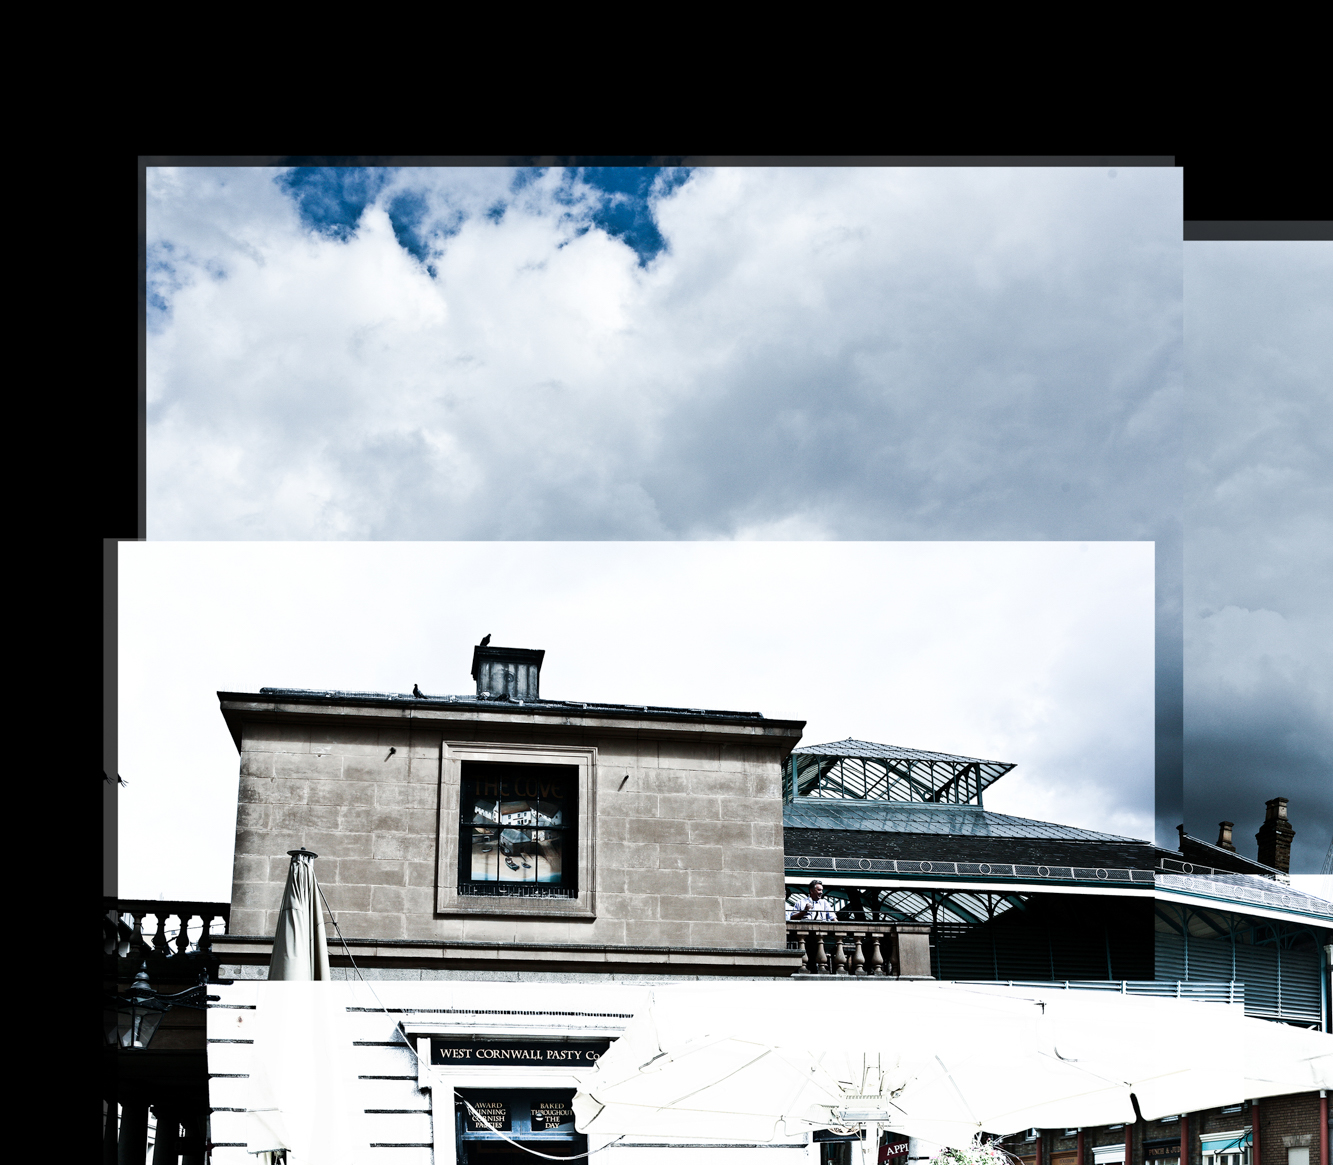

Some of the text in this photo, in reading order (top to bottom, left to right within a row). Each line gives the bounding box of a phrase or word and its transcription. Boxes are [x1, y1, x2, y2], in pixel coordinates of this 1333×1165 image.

[472, 775, 564, 799] THE COVE
[440, 1048, 473, 1060] WEST
[475, 1049, 543, 1061] CORNWALL
[546, 1050, 582, 1061] PASTY
[545, 1115, 560, 1123] THE
